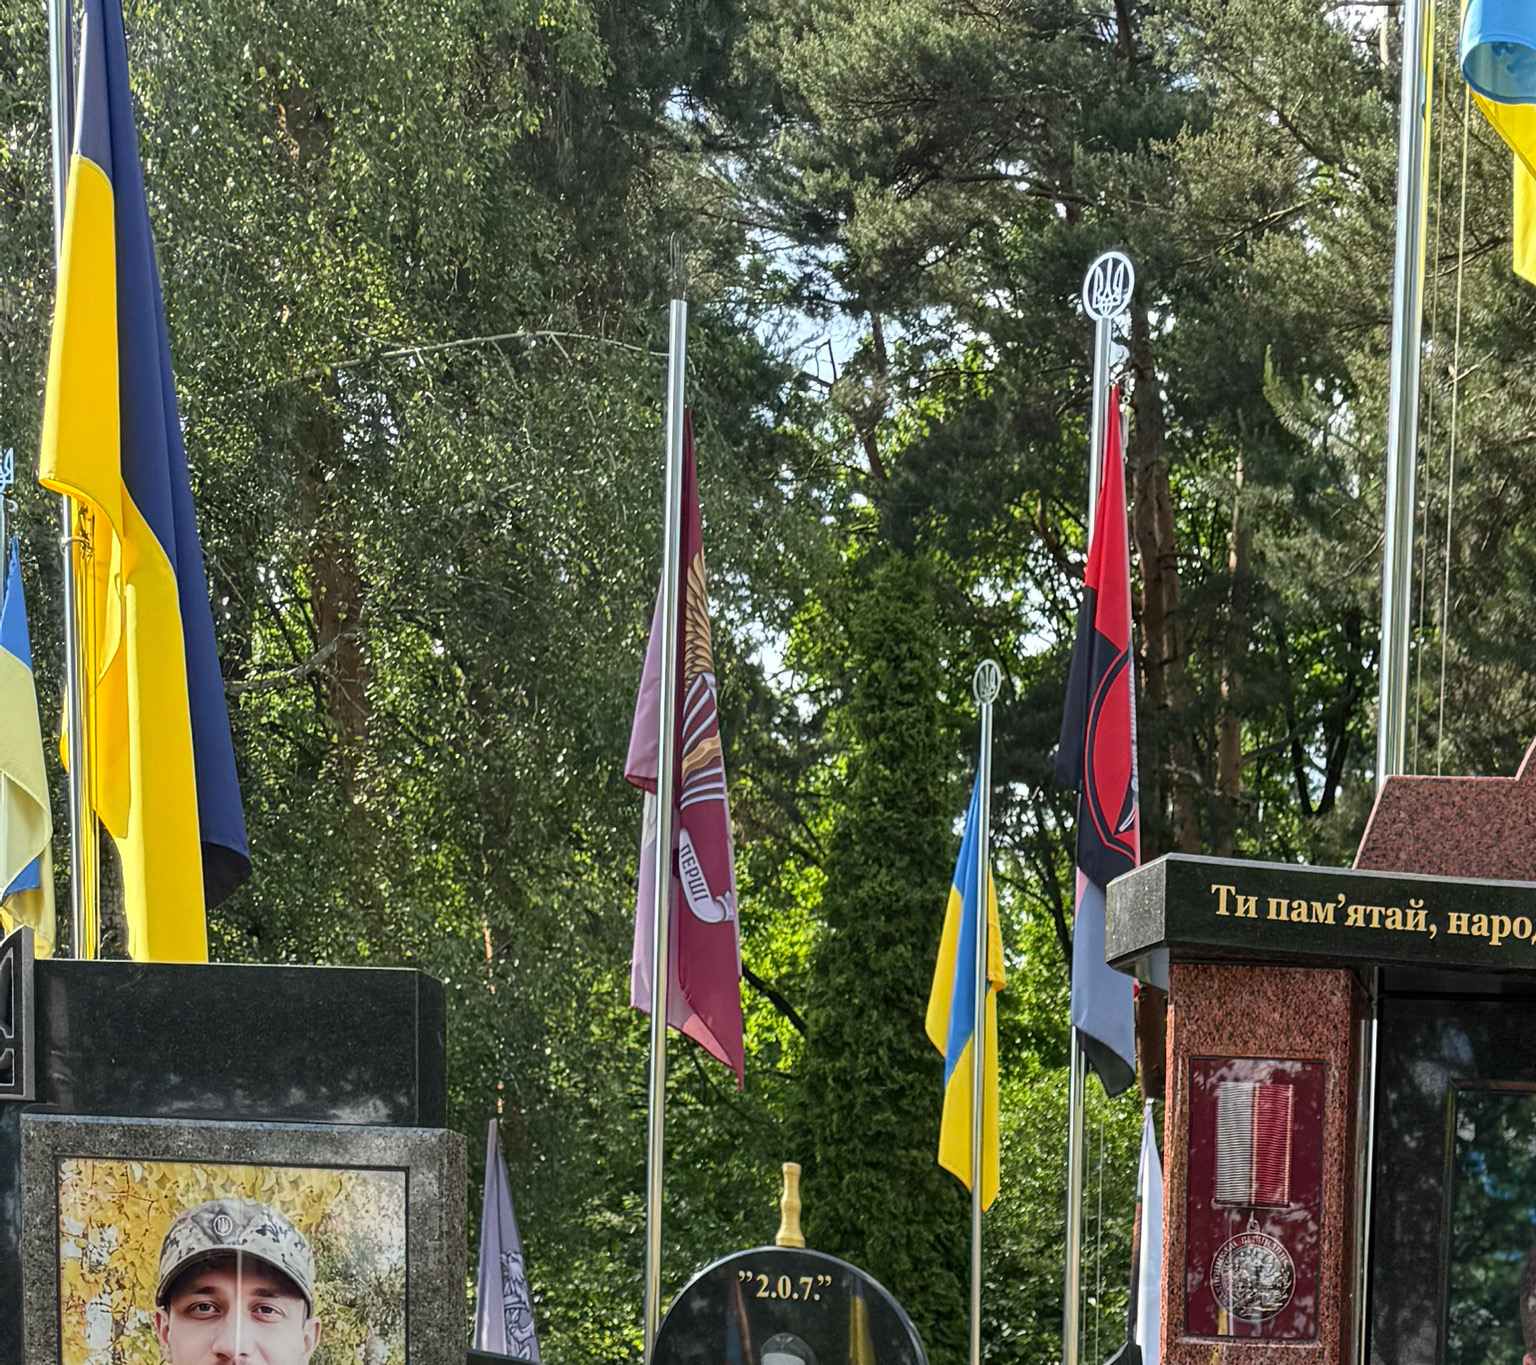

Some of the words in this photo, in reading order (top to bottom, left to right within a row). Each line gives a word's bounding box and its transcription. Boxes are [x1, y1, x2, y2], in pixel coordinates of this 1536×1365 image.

[680, 843, 709, 902] ПЕРШІ
[1211, 885, 1258, 918] Ти
[1267, 893, 1438, 940] пам’ятай,
